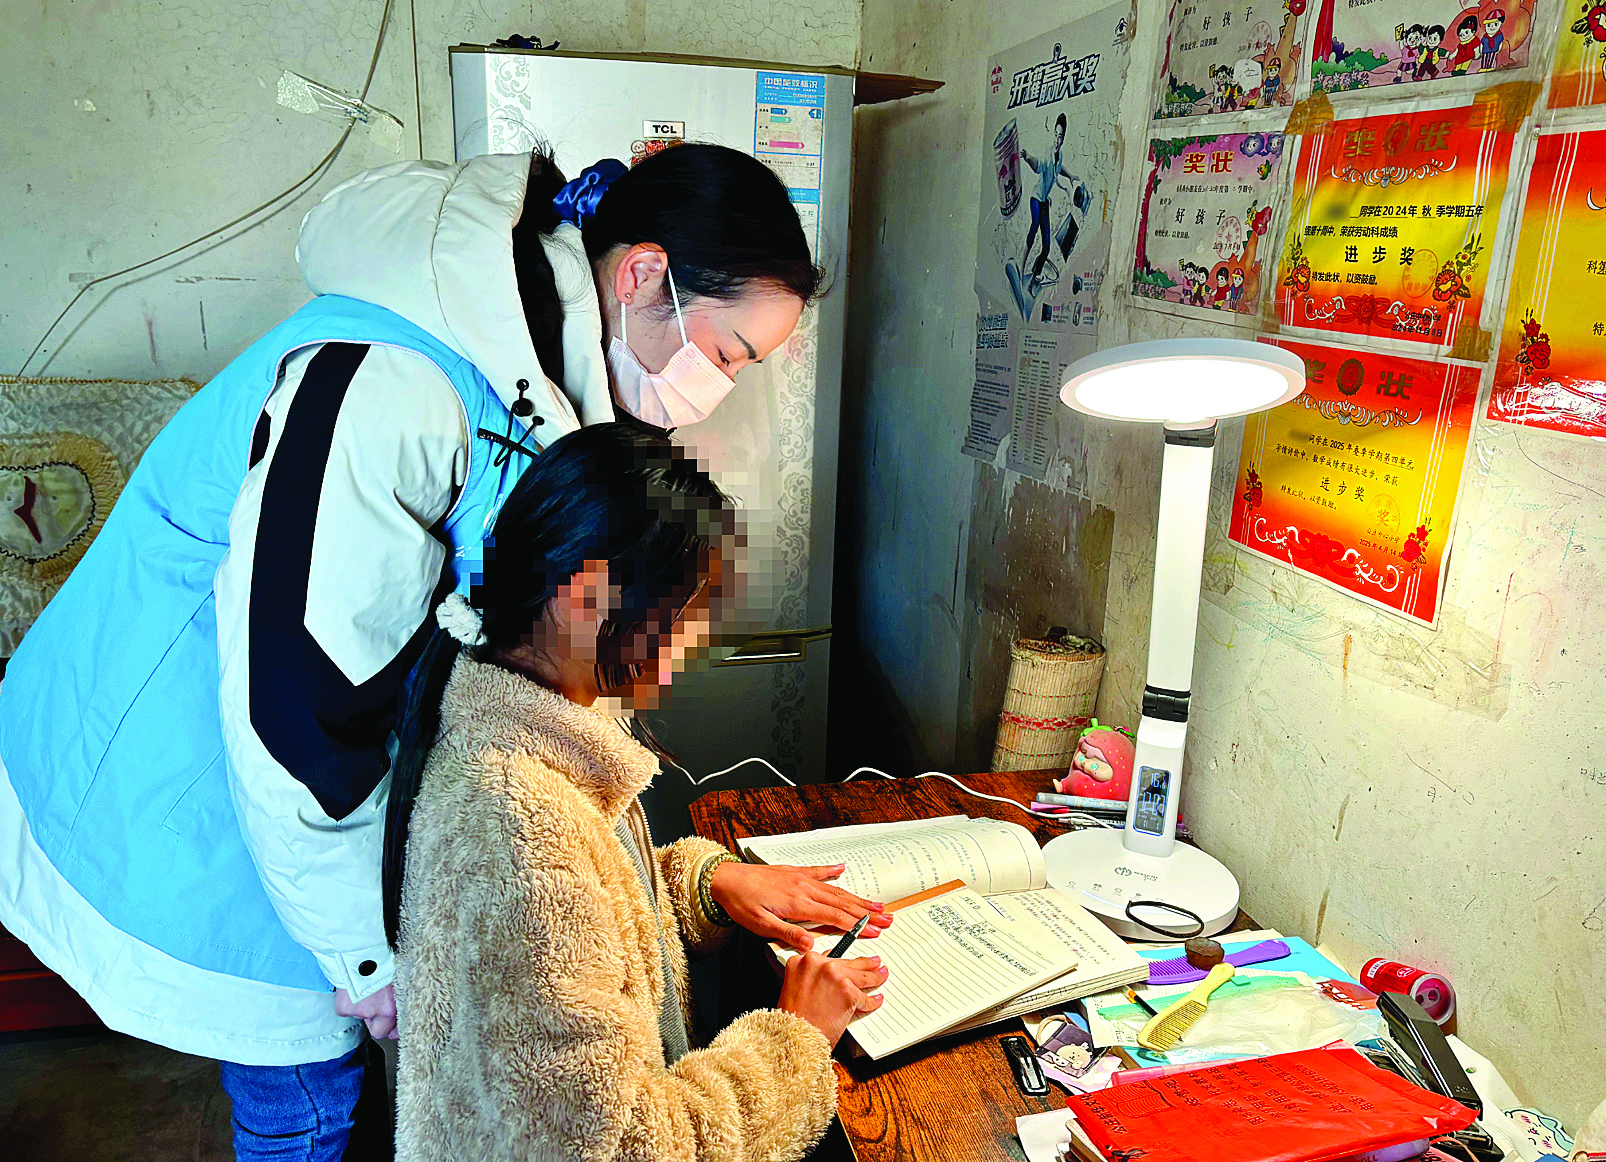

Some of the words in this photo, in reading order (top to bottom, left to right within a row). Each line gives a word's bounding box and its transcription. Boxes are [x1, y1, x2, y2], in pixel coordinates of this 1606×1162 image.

[1007, 53, 1100, 109] 开罐赢大奖
[652, 124, 677, 134] TCL
[1183, 151, 1234, 174] 奖状
